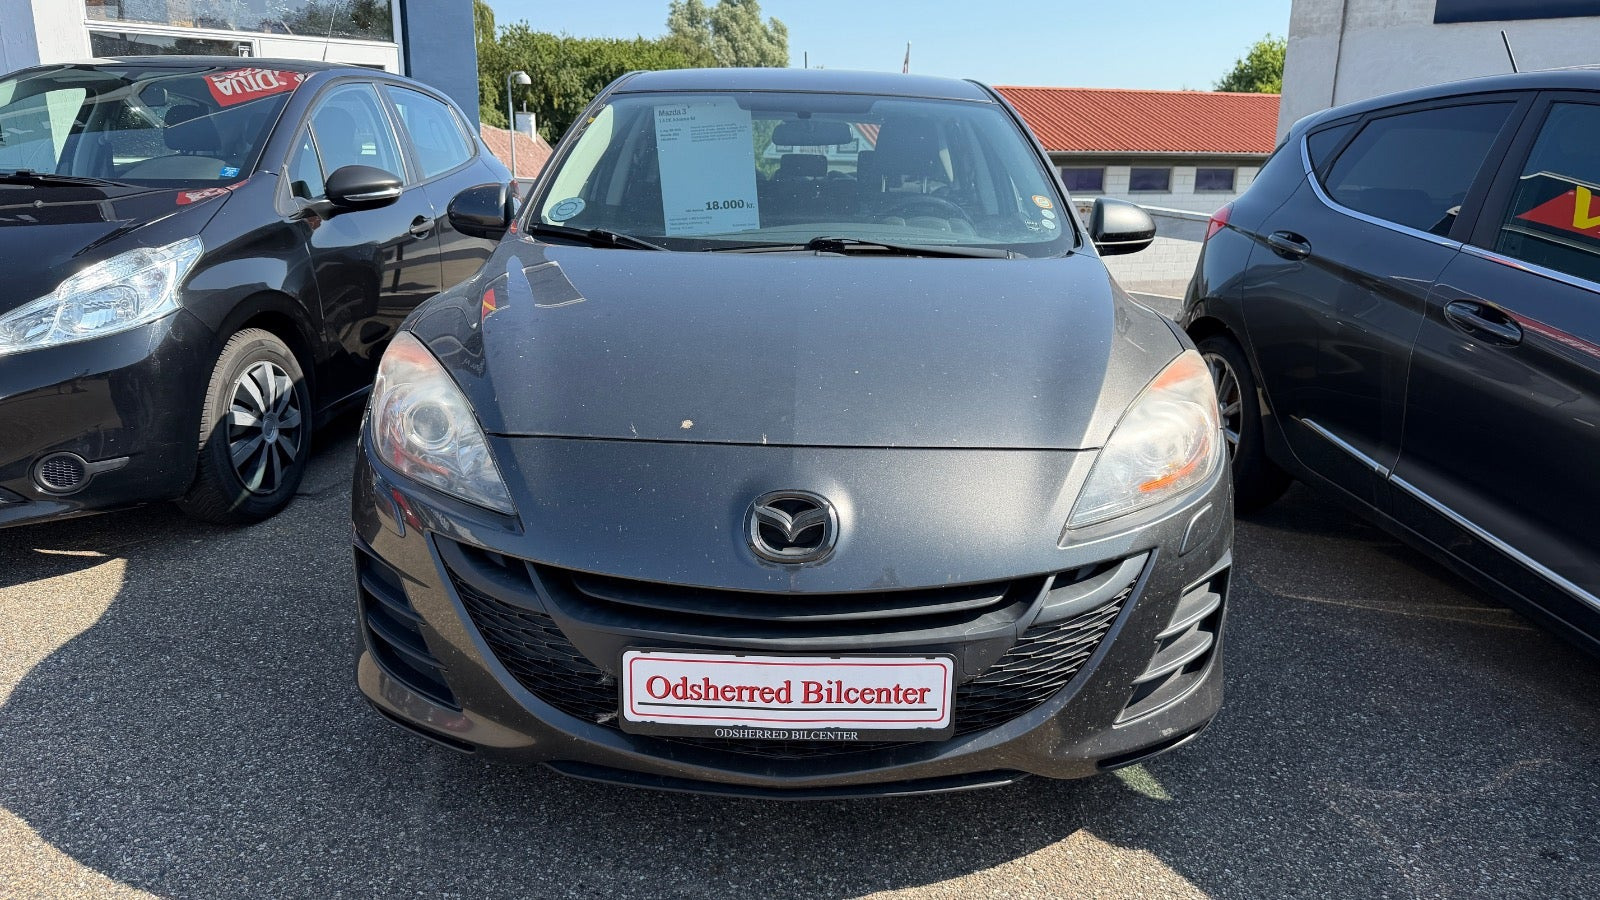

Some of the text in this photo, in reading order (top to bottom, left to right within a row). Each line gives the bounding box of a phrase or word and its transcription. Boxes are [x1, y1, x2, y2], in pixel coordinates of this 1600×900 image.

[658, 109, 682, 117] Mazda
[705, 199, 744, 211] 18.000
[645, 675, 931, 705] Odsherred Bilcenter
[714, 728, 859, 741] ODSHERRED BILCENTER
